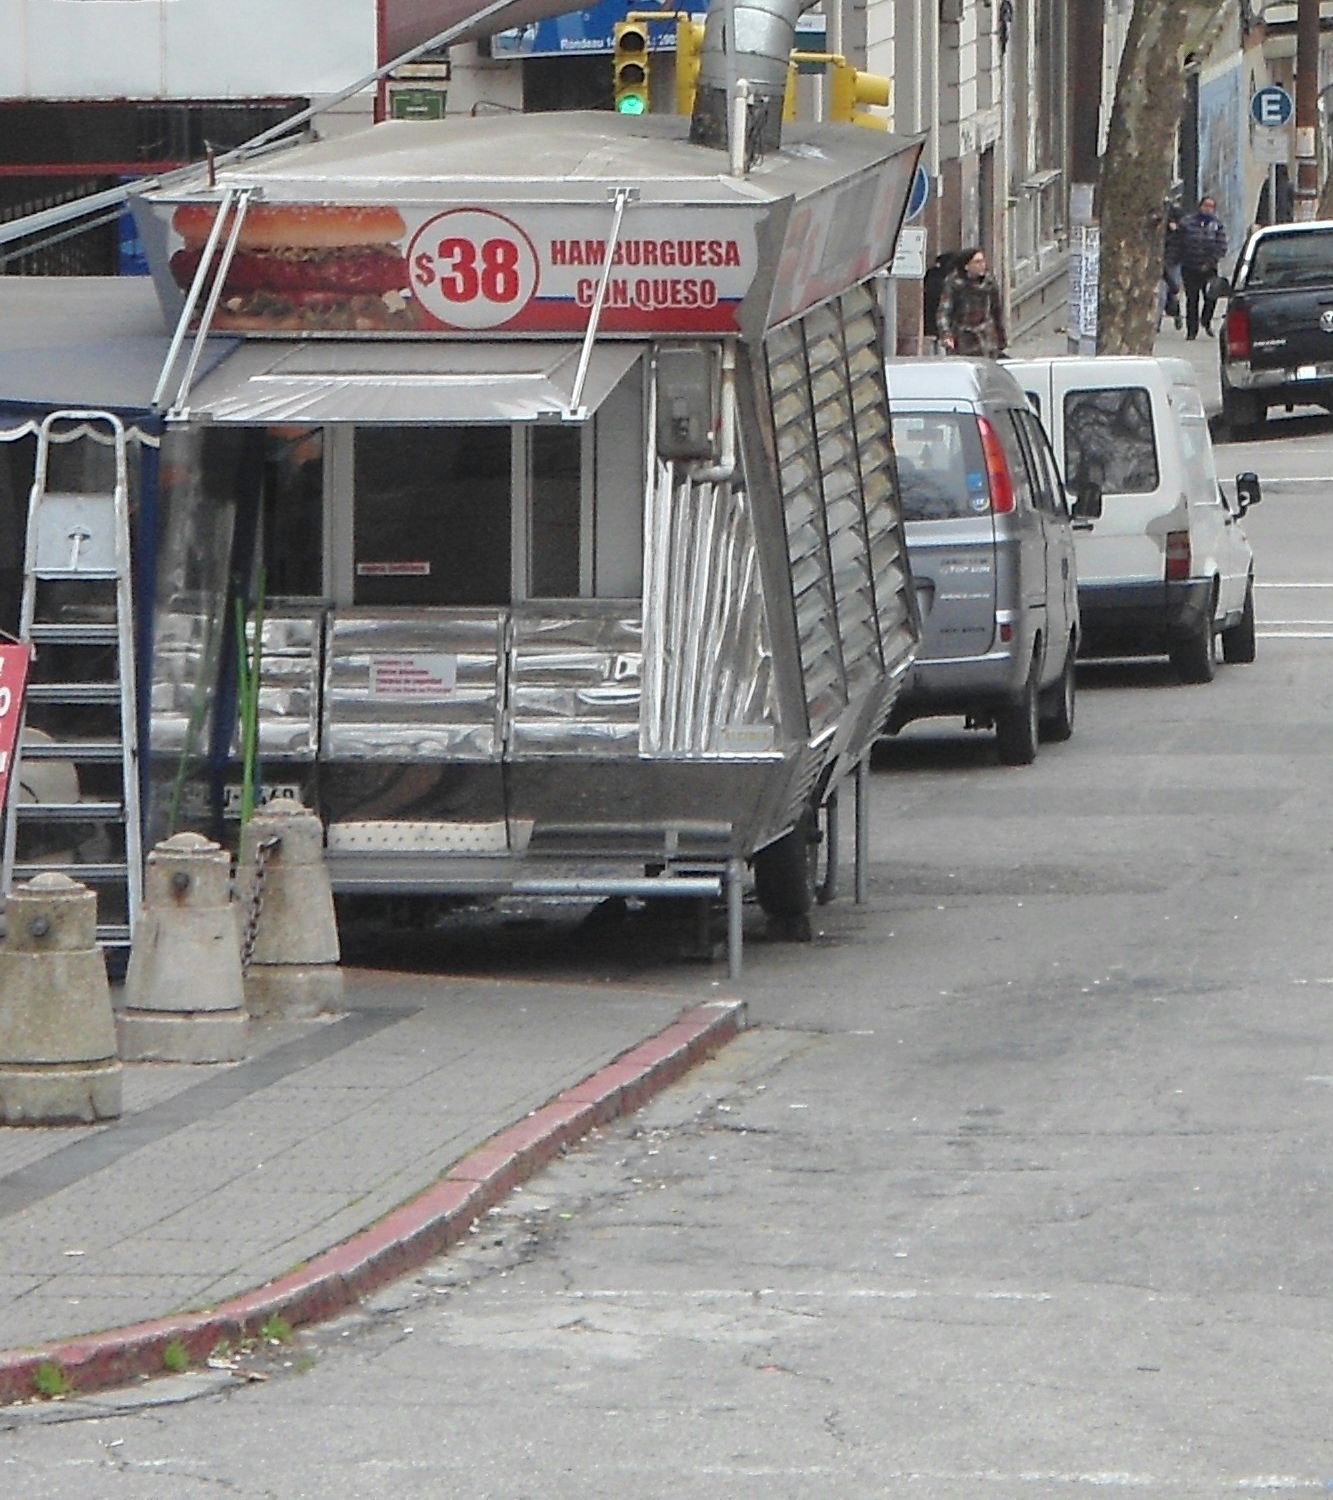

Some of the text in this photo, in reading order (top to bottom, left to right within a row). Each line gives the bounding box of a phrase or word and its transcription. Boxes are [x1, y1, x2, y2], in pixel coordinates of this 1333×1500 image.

[1261, 93, 1282, 121] E
[551, 240, 741, 267] HAMBURGUESA
[415, 238, 520, 305] $38
[635, 279, 718, 311] QUESO
